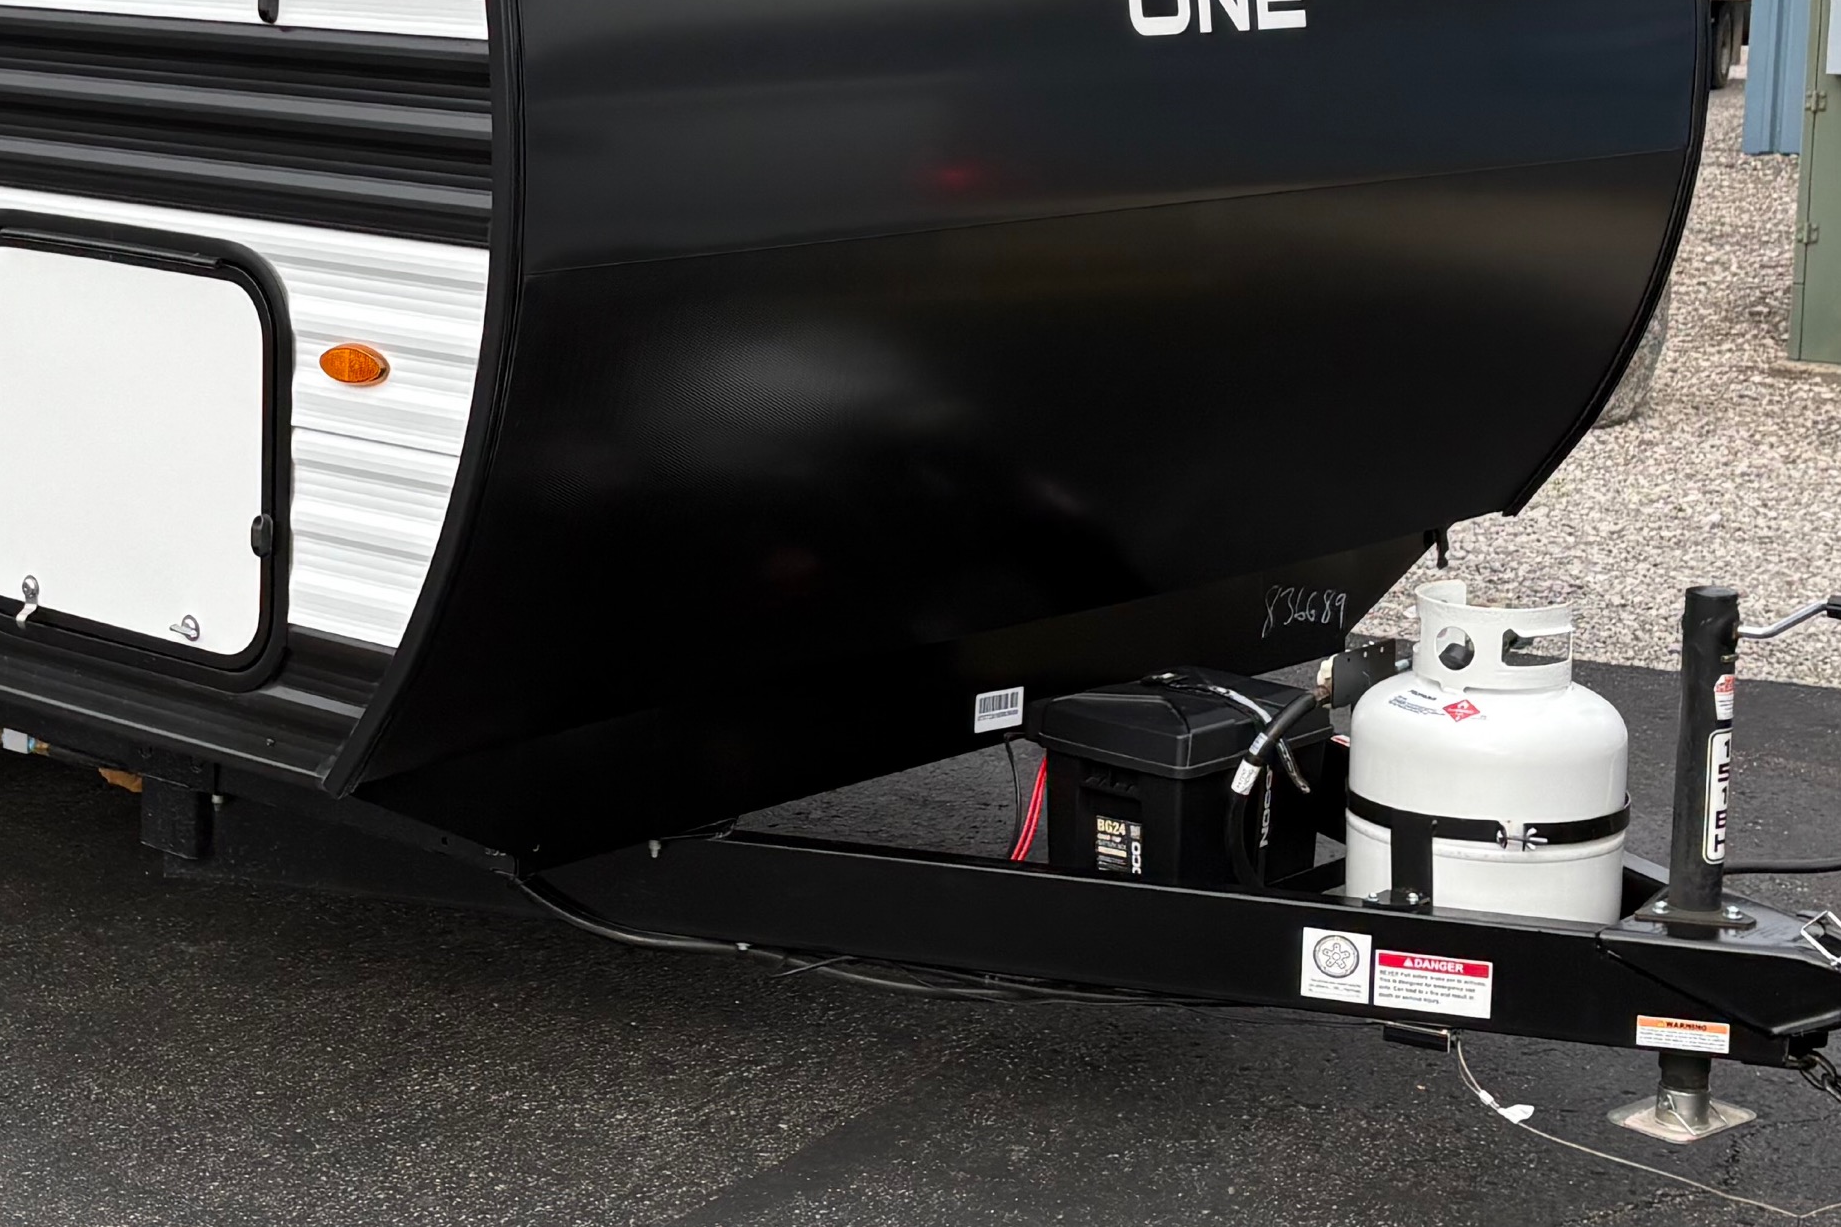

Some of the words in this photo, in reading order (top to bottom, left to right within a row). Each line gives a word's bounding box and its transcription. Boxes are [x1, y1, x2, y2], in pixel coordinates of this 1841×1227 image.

[1261, 585, 1347, 638] 836689
[1096, 818, 1126, 835] BG24
[1414, 958, 1463, 973] DANGER
[1666, 1021, 1707, 1032] WARNING
